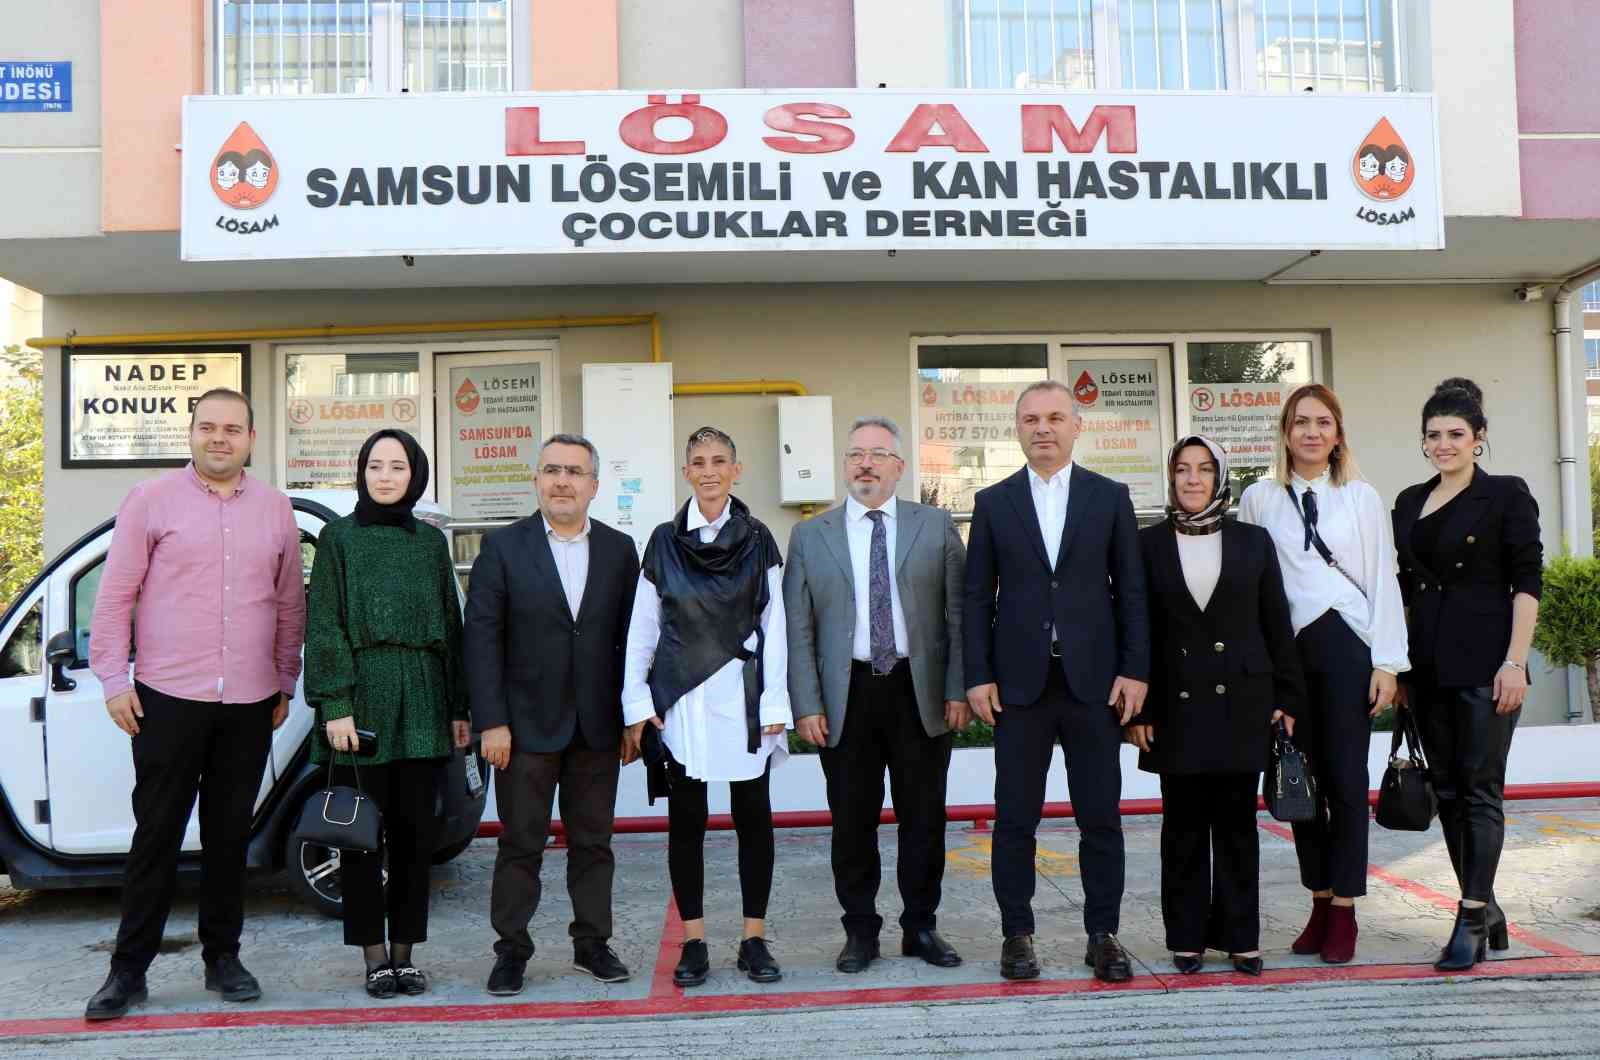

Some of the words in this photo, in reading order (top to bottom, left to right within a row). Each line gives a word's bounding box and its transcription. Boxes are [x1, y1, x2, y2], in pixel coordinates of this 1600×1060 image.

[11, 63, 54, 79] İNÖNÜ
[505, 94, 1138, 157] LÖSAM
[306, 164, 531, 208] SAMSUN
[822, 169, 882, 201] ve
[912, 160, 1018, 199] KAN
[1036, 160, 1328, 200] HASTALIKLI
[215, 213, 280, 235] LÖSAM
[1355, 205, 1416, 226] LÖSAM
[562, 210, 849, 247] ÇOCUKLAR
[105, 364, 208, 382] NADEP
[1102, 371, 1152, 384] LÖSEMİ
[484, 375, 535, 391] LÖSEMİ
[952, 385, 1016, 405] LÖSAM
[1220, 388, 1281, 408] LÖSAM
[83, 397, 177, 414] KONUK
[320, 401, 385, 420] LÖSAM
[977, 412, 1017, 422] TELEFO
[459, 425, 533, 442] SAMSUN'DA
[925, 427, 934, 439] 0
[939, 427, 965, 439] 537
[971, 427, 999, 439] 570
[474, 444, 518, 459] LÖSAM
